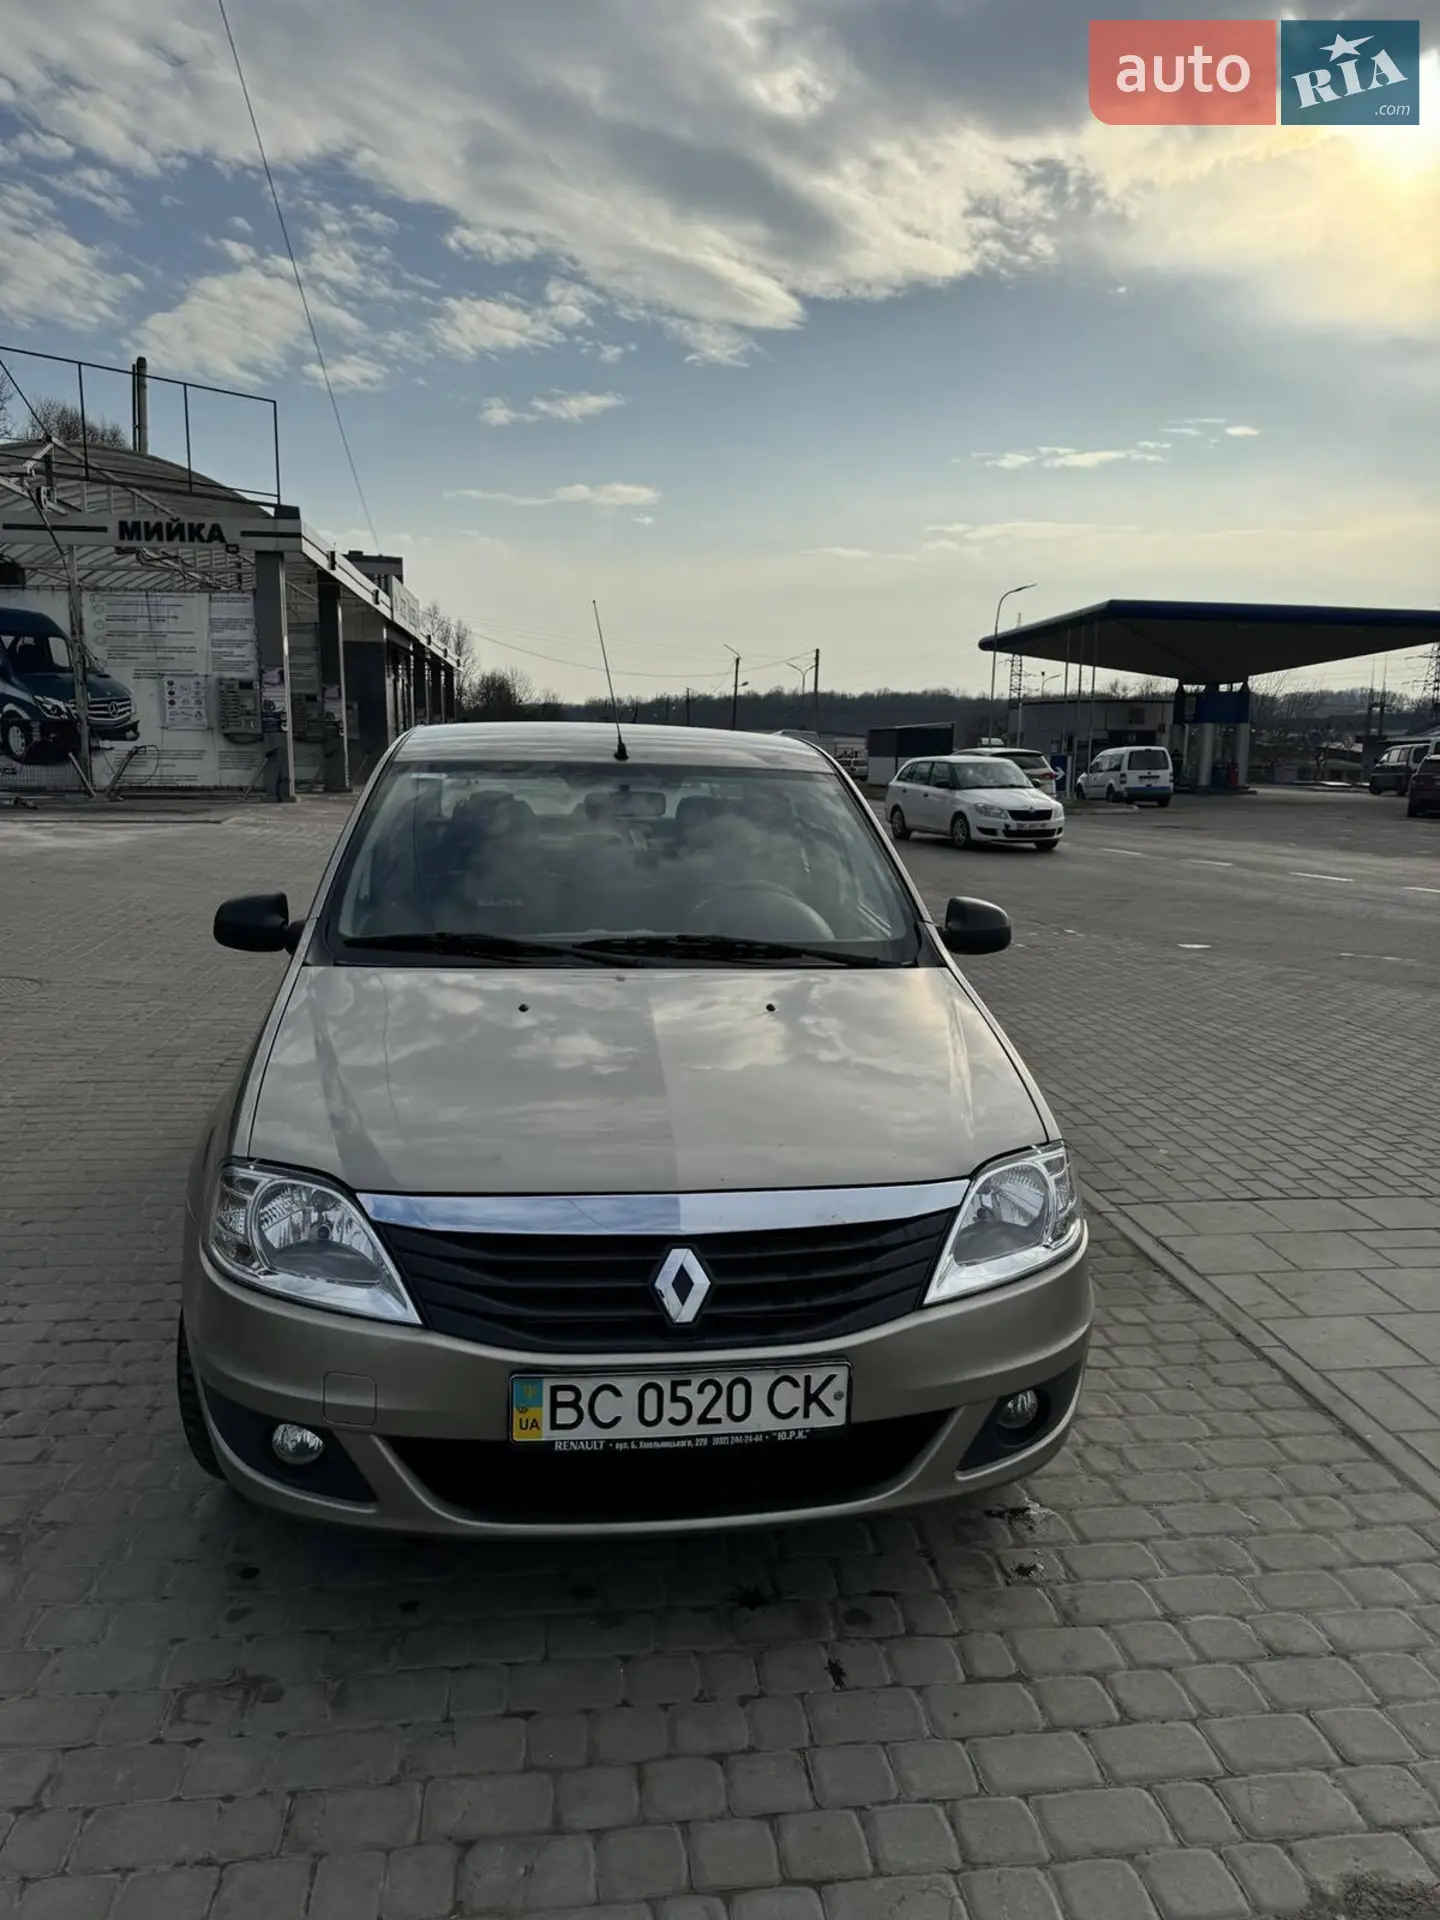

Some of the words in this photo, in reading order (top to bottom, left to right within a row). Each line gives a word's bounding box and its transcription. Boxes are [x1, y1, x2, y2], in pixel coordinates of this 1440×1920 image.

[118, 517, 227, 543] МИЙКА
[550, 1383, 623, 1431] BC
[637, 1376, 752, 1428] 0520
[767, 1374, 838, 1420] CK
[519, 1418, 541, 1431] UA
[554, 1440, 605, 1451] RENAULT
